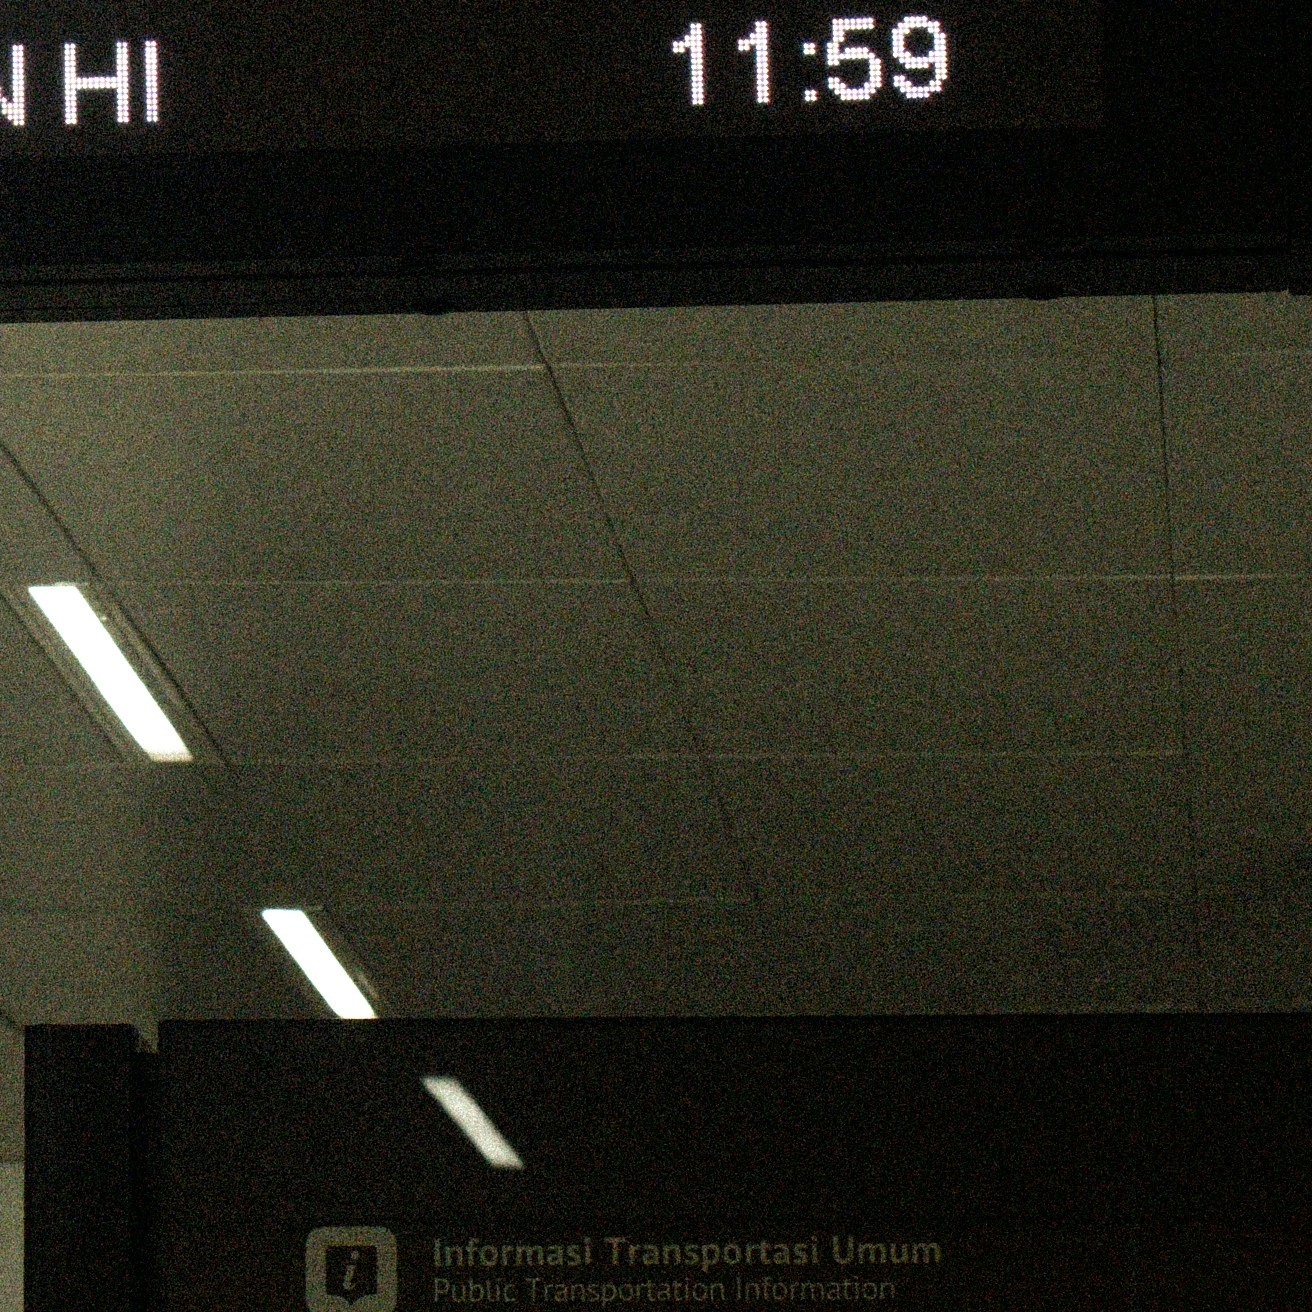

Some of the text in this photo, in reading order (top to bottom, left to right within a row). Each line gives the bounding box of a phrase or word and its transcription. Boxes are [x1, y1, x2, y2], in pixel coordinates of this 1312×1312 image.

[62, 39, 161, 126] HI
[670, 14, 950, 107] 11:59
[432, 1235, 943, 1274] Informasi Transportasi Umum
[433, 1276, 897, 1308] Public Transportation Information
